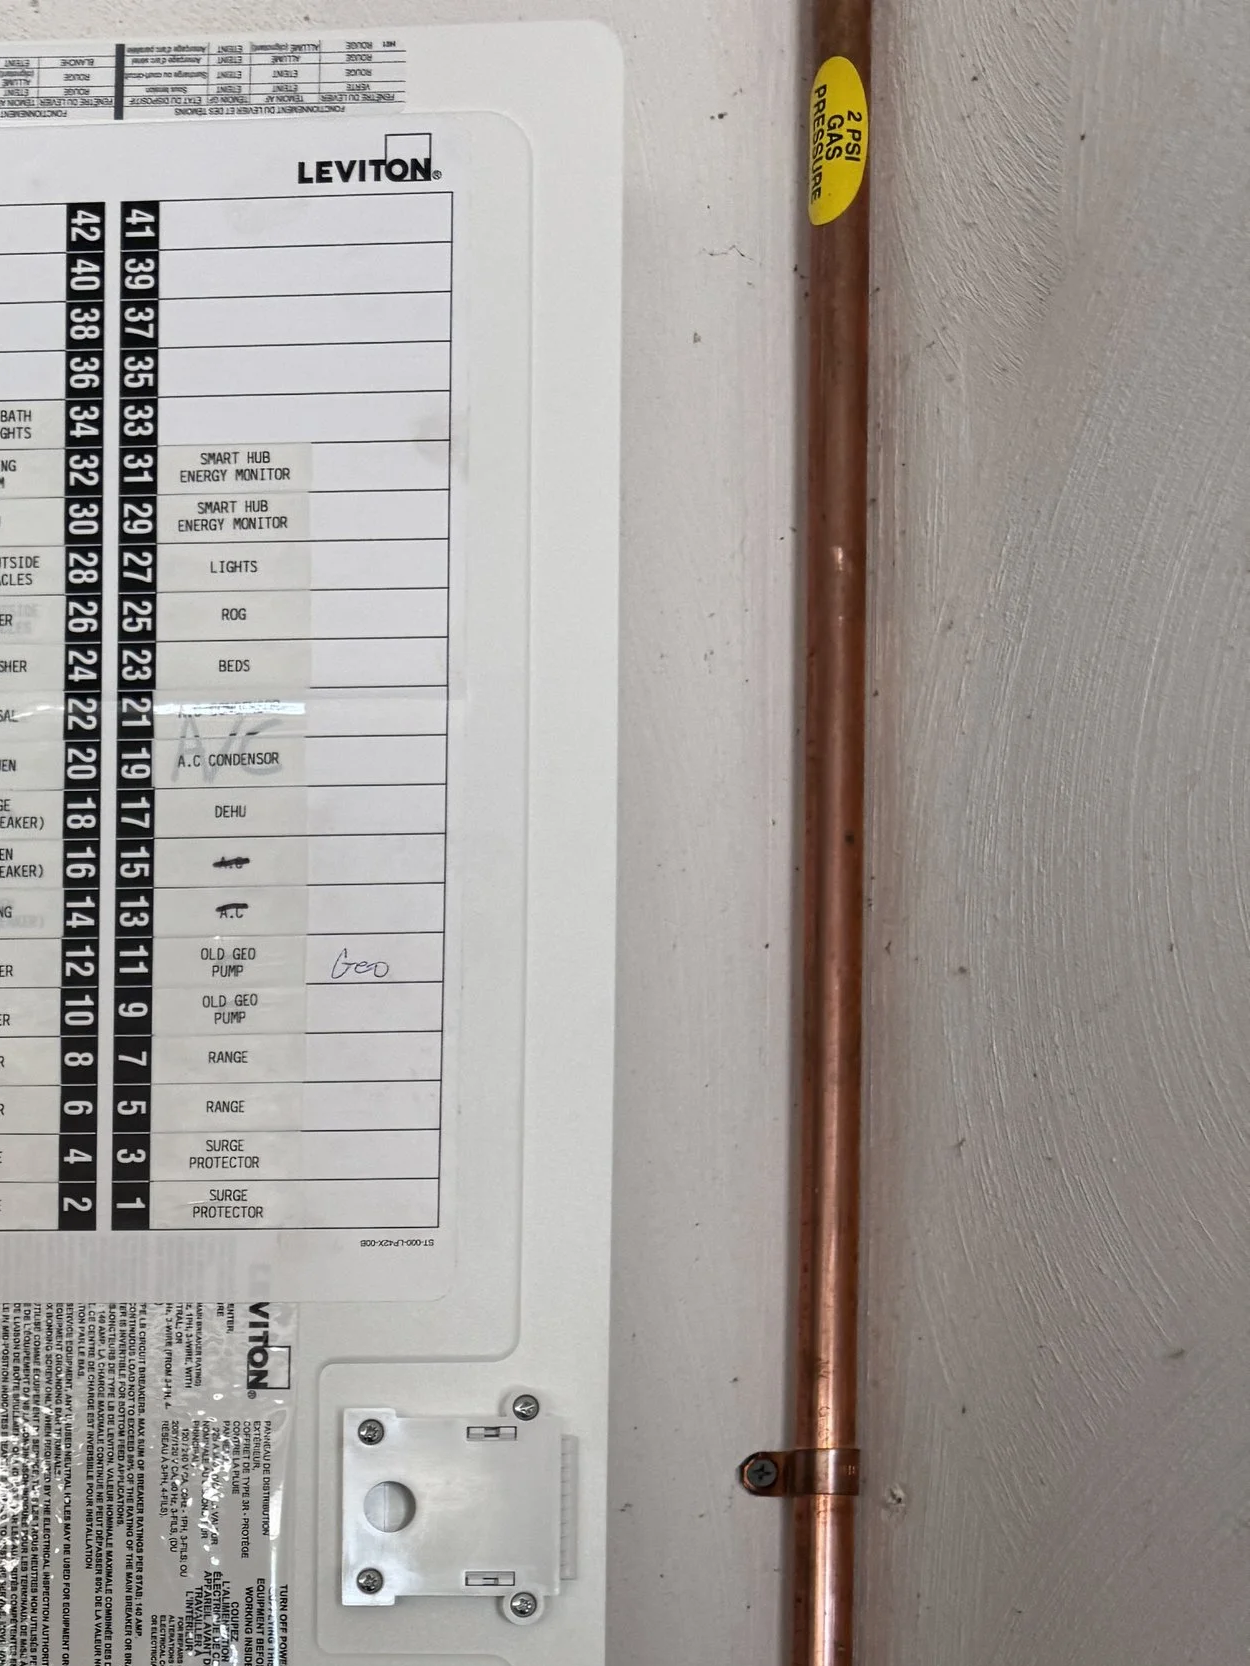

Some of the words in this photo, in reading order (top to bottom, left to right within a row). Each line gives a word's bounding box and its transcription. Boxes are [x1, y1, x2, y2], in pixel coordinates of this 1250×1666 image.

[63, 73, 90, 81] ROUGE
[345, 69, 372, 77] ROUGE
[346, 83, 370, 92] VERTE
[846, 109, 862, 123] 2
[810, 84, 828, 205] PRESSURE
[824, 114, 844, 160] GAS
[845, 128, 861, 162] PSI
[70, 209, 101, 242] 42
[125, 208, 156, 238] 41
[70, 258, 101, 291] 40
[124, 258, 155, 290] 39
[69, 308, 101, 340] 38
[124, 307, 155, 339] 37
[69, 357, 100, 389] 36
[123, 356, 155, 388] 35
[0, 409, 32, 423] BATH
[69, 405, 100, 438] 34
[123, 405, 154, 437] 33
[68, 454, 100, 486] 32
[123, 454, 154, 483] 31
[200, 451, 240, 466] SMART
[247, 450, 271, 464] HUB
[180, 469, 228, 484] ENERGY
[235, 467, 291, 482] MONITOR
[68, 503, 99, 535] 30
[122, 503, 154, 535] 29
[197, 500, 238, 515] SMART
[244, 499, 269, 513] HUB
[177, 518, 225, 533] ENERGY
[232, 515, 288, 530] MONITOR
[68, 552, 99, 584] 28
[122, 551, 153, 583] 27
[210, 560, 258, 574] LIGHTS
[67, 601, 99, 633] 26
[121, 600, 153, 633] 25
[221, 607, 247, 621] ROG
[68, 650, 98, 682] 24
[121, 649, 152, 681] 23
[218, 659, 251, 673] BEDS
[67, 698, 98, 730] 22
[121, 697, 152, 727] 21
[66, 747, 97, 780] 20
[120, 747, 151, 779] 19
[177, 754, 201, 768] A.C
[208, 751, 279, 767] CONDENSOR
[66, 797, 97, 830] 18
[120, 796, 151, 829] 17
[214, 805, 247, 819] DEHU
[65, 846, 96, 879] 16
[119, 846, 150, 879] 15
[65, 896, 95, 928] 14
[119, 895, 150, 928] 13
[65, 945, 95, 977] 12
[119, 944, 149, 974] 11
[200, 947, 225, 961] OLD
[232, 947, 256, 961] GEO
[211, 964, 244, 978] PUMP
[64, 994, 95, 1026] 10
[118, 1002, 149, 1018] 9
[202, 994, 227, 1009] OLD
[234, 993, 258, 1007] GEO
[214, 1010, 246, 1025] PUMP
[63, 1051, 94, 1067] 8
[118, 1050, 148, 1067] 7
[208, 1050, 248, 1064] RANGE
[62, 1100, 93, 1117] 6
[117, 1100, 147, 1116] 5
[206, 1100, 245, 1113] RANGE
[63, 1148, 93, 1165] 4
[116, 1148, 147, 1164] 3
[205, 1139, 244, 1152] SURGE
[189, 1155, 260, 1169] PROTECTOR
[63, 1197, 93, 1212] 2
[116, 1197, 146, 1209] 1
[209, 1188, 248, 1202] SURGE
[192, 1205, 264, 1219] PROTECTOR
[247, 1302, 269, 1389] VITON
[244, 1587, 253, 1634] WORKING
[255, 1578, 265, 1636] EQUIPMENT
[279, 1584, 288, 1612] TURN
[230, 1601, 239, 1642] COUPEZ
[279, 1614, 288, 1634] OFF
